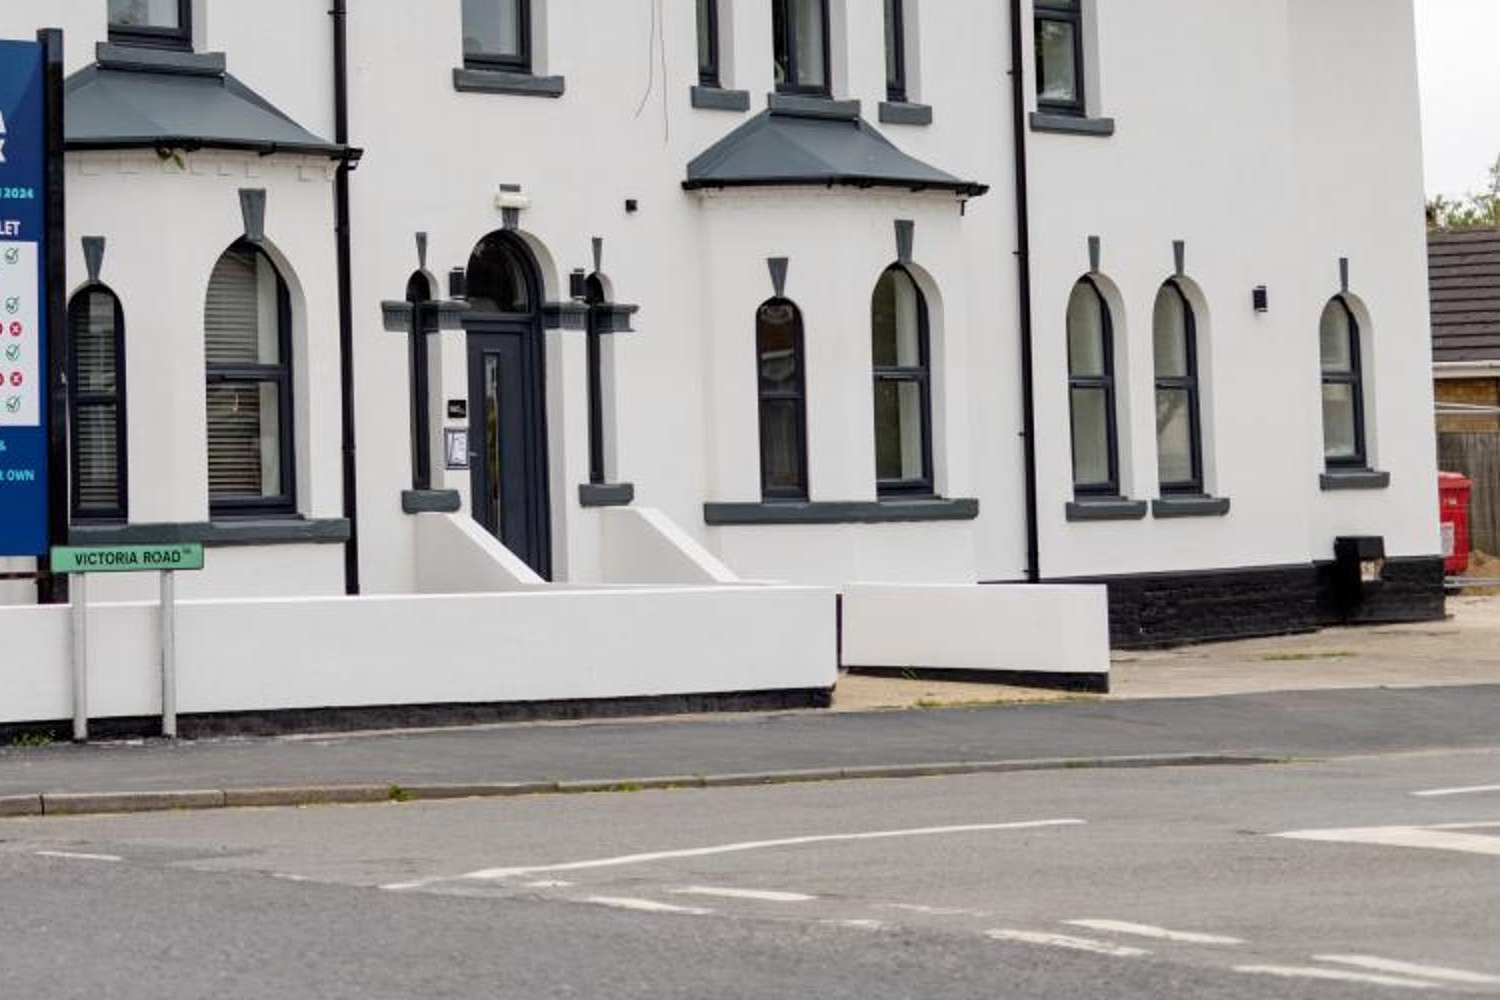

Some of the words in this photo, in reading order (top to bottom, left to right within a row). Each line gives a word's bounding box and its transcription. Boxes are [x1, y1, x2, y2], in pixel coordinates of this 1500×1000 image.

[3, 187, 34, 199] 2024
[6, 470, 35, 481] OWN
[75, 552, 138, 566] VICTORIA
[143, 551, 181, 564] ROAD
